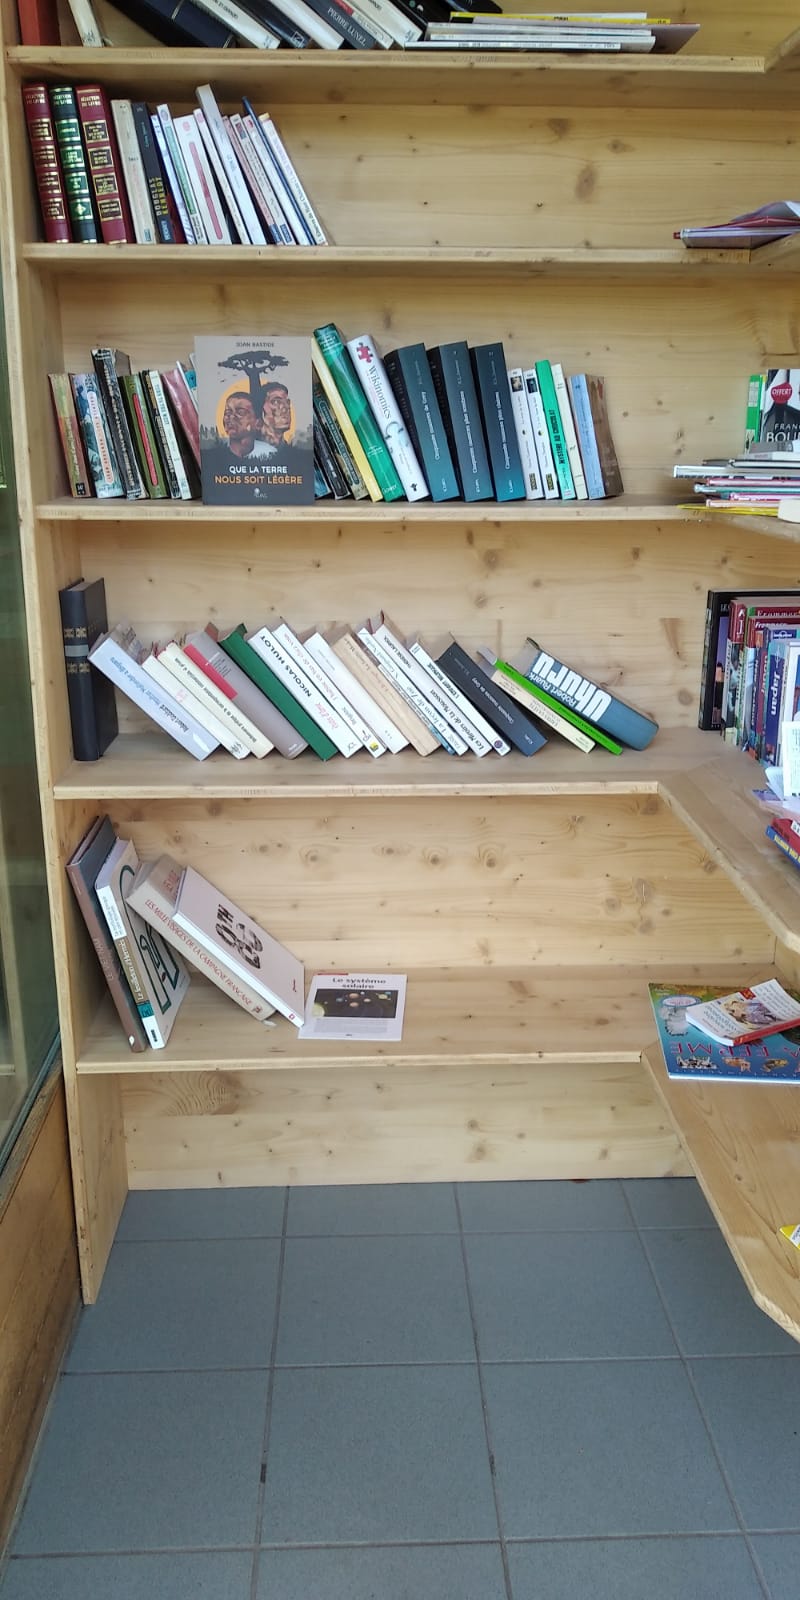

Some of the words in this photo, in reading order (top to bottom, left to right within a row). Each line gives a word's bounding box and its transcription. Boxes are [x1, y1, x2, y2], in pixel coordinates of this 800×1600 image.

[326, 6, 351, 30] PIERRE
[348, 26, 368, 46] LUNEL
[148, 177, 162, 216] DOUGLAS
[364, 364, 395, 420] Wikinomics
[419, 390, 428, 404] Grey
[766, 431, 800, 443] BOU
[214, 476, 242, 484] NOUS
[244, 476, 264, 484] SOIT
[267, 474, 303, 484] LÉGÈRE
[229, 466, 246, 474] QUE
[259, 633, 285, 664] HULOT
[283, 663, 312, 698] NICOLAS
[470, 675, 482, 687] Grey
[527, 670, 551, 691] Ruark
[532, 651, 612, 722] Uhuru
[549, 685, 577, 708] Robert
[770, 672, 781, 716] Japan
[448, 710, 455, 718] la
[452, 716, 462, 725] de
[496, 703, 516, 725] Cinquante
[174, 717, 189, 733] Robert
[458, 722, 476, 742] Miroirs
[473, 739, 484, 751] Les
[144, 898, 156, 910] LES
[152, 906, 168, 922] MILLE
[164, 917, 188, 941] VISAGES
[184, 938, 194, 948] DE
[191, 944, 201, 955] LA
[198, 951, 227, 980] CAMPAGNE
[136, 991, 144, 1000] Le
[670, 1042, 770, 1058] FERME
